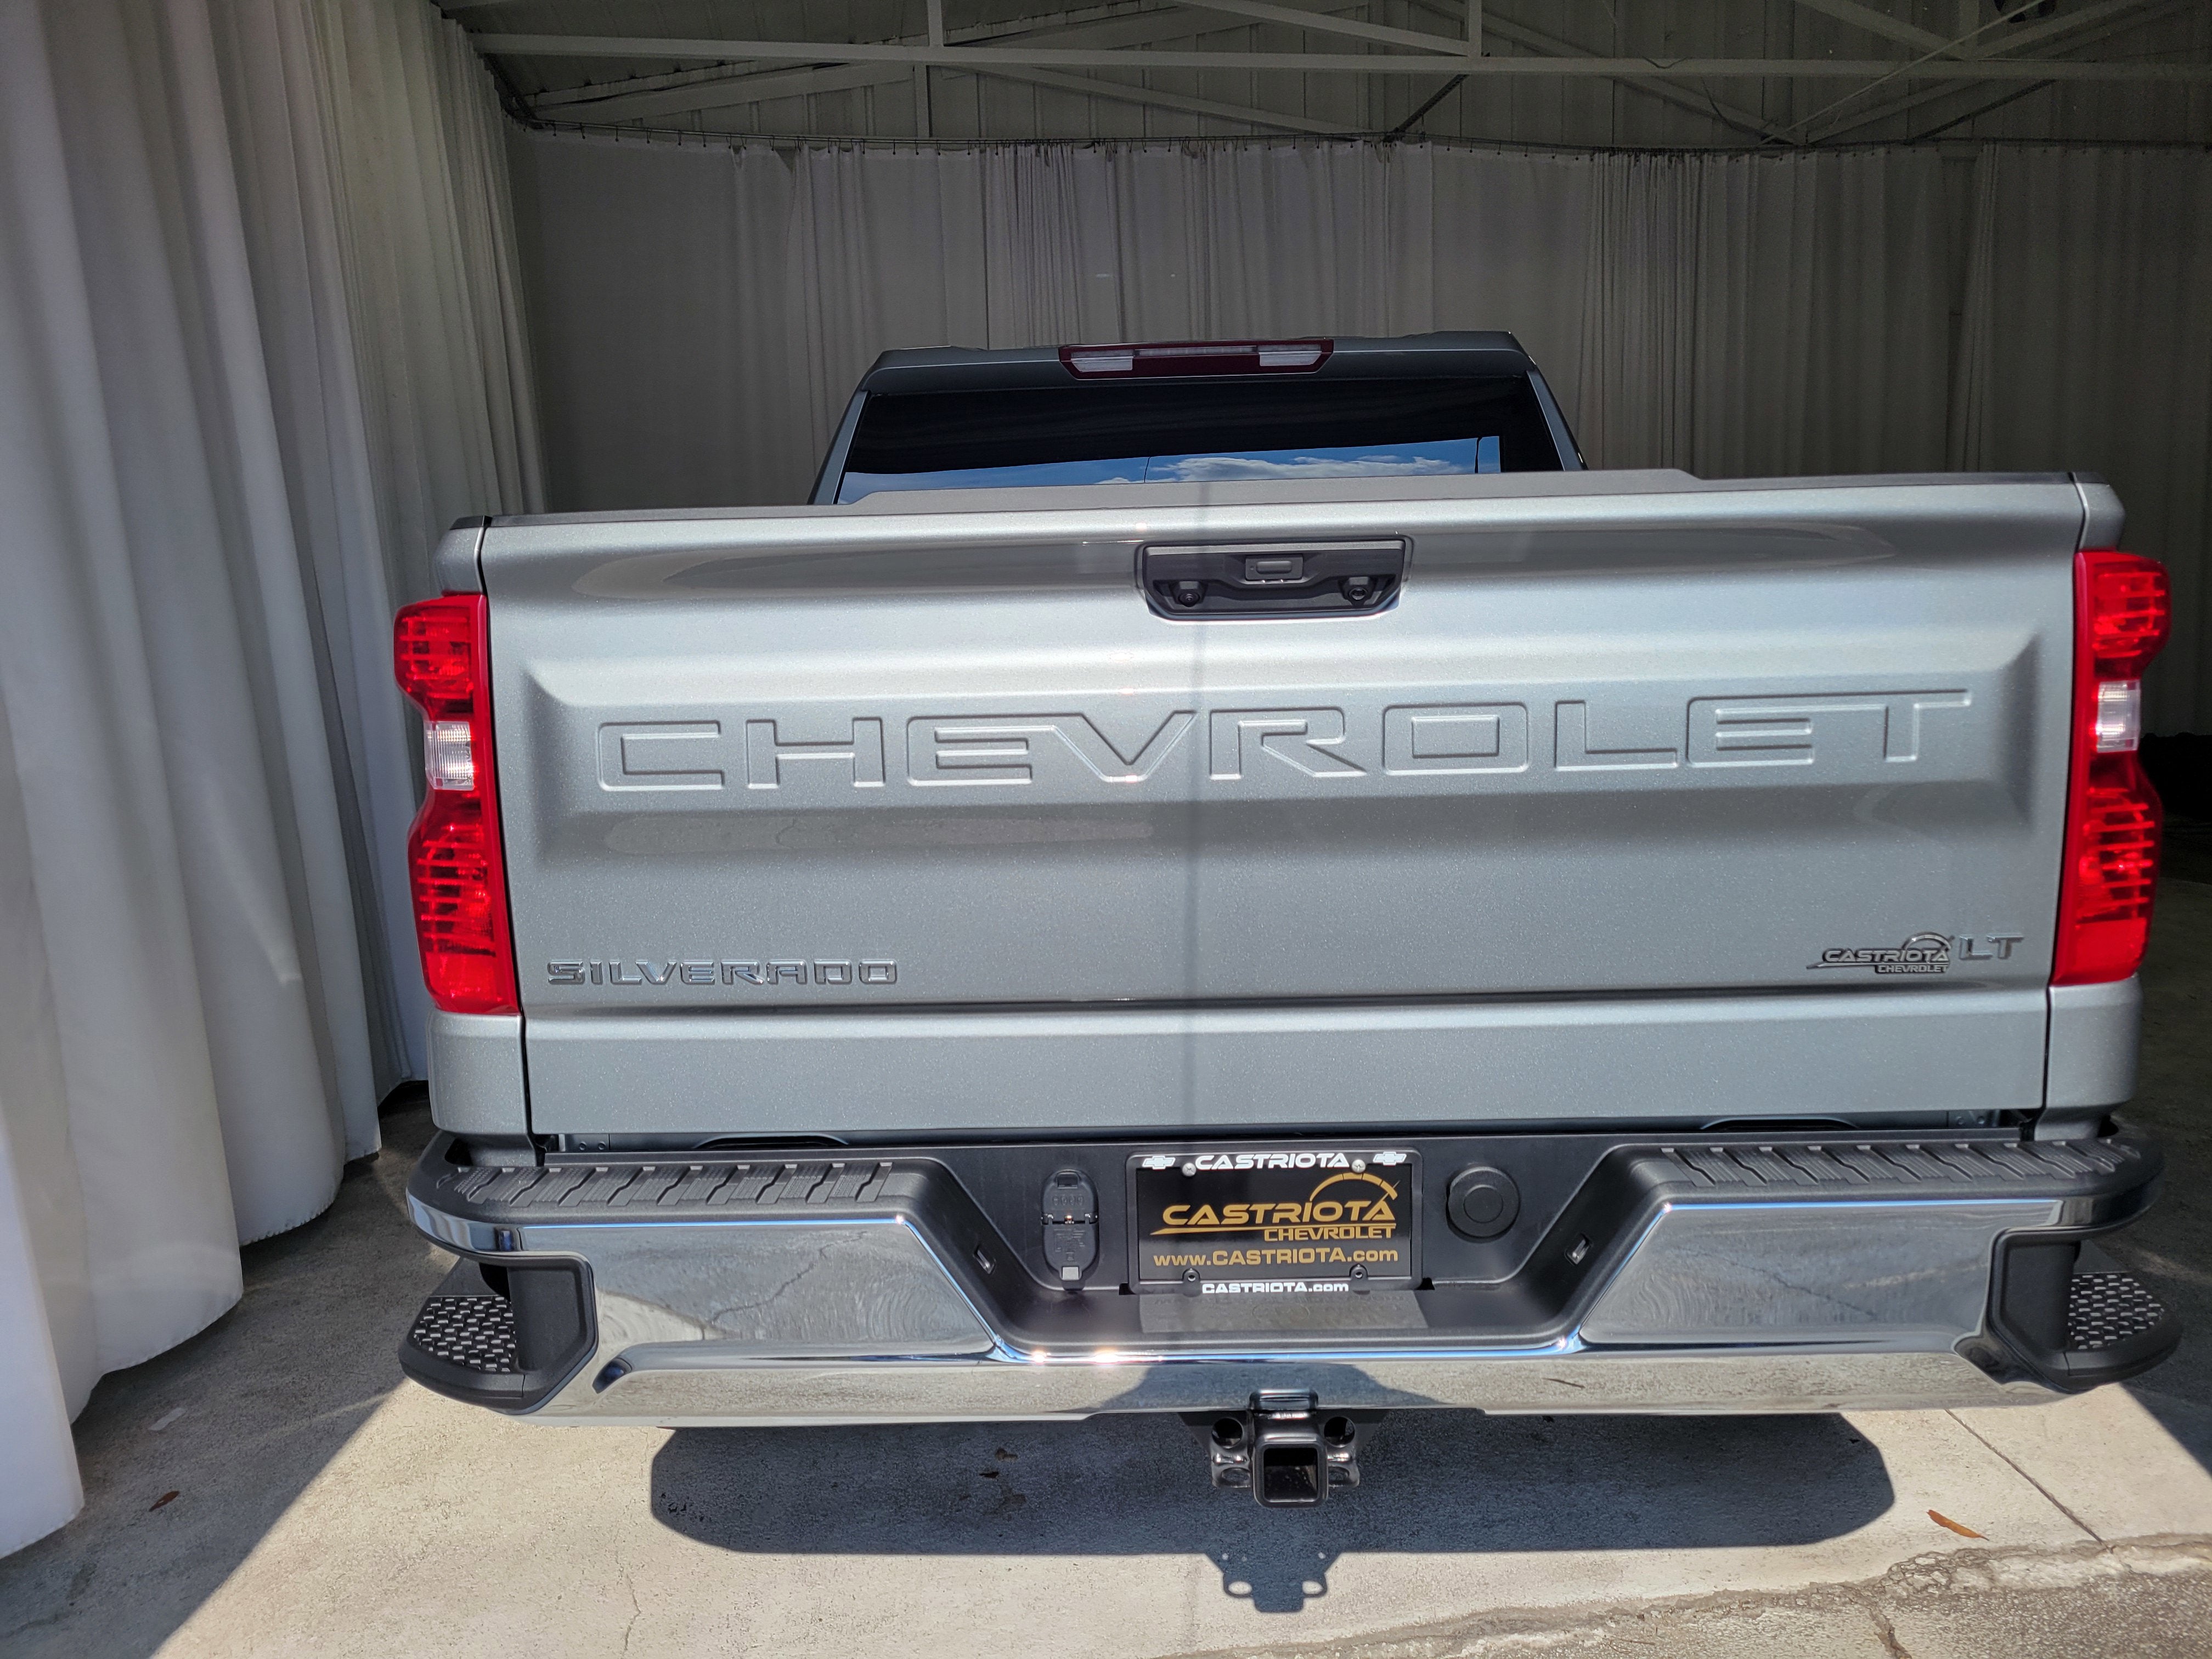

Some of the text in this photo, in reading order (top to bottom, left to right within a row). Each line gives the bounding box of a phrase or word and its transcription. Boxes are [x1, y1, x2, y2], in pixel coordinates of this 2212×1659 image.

[598, 690, 1972, 791] CHEVROLET
[1822, 948, 1950, 963] CASTRIOTA
[1959, 934, 2024, 960] LT
[548, 960, 898, 985] SILVERADO
[1876, 964, 1949, 973] CHEVROLET
[1195, 1153, 1350, 1170] CASTRIOTA
[1162, 1201, 1396, 1225] CASTRIOTA
[1264, 1226, 1396, 1242] CHEVROLET
[1153, 1247, 1398, 1266] www.CASTRIOTA.com
[1201, 1281, 1349, 1294] CASTRIOTA.com
